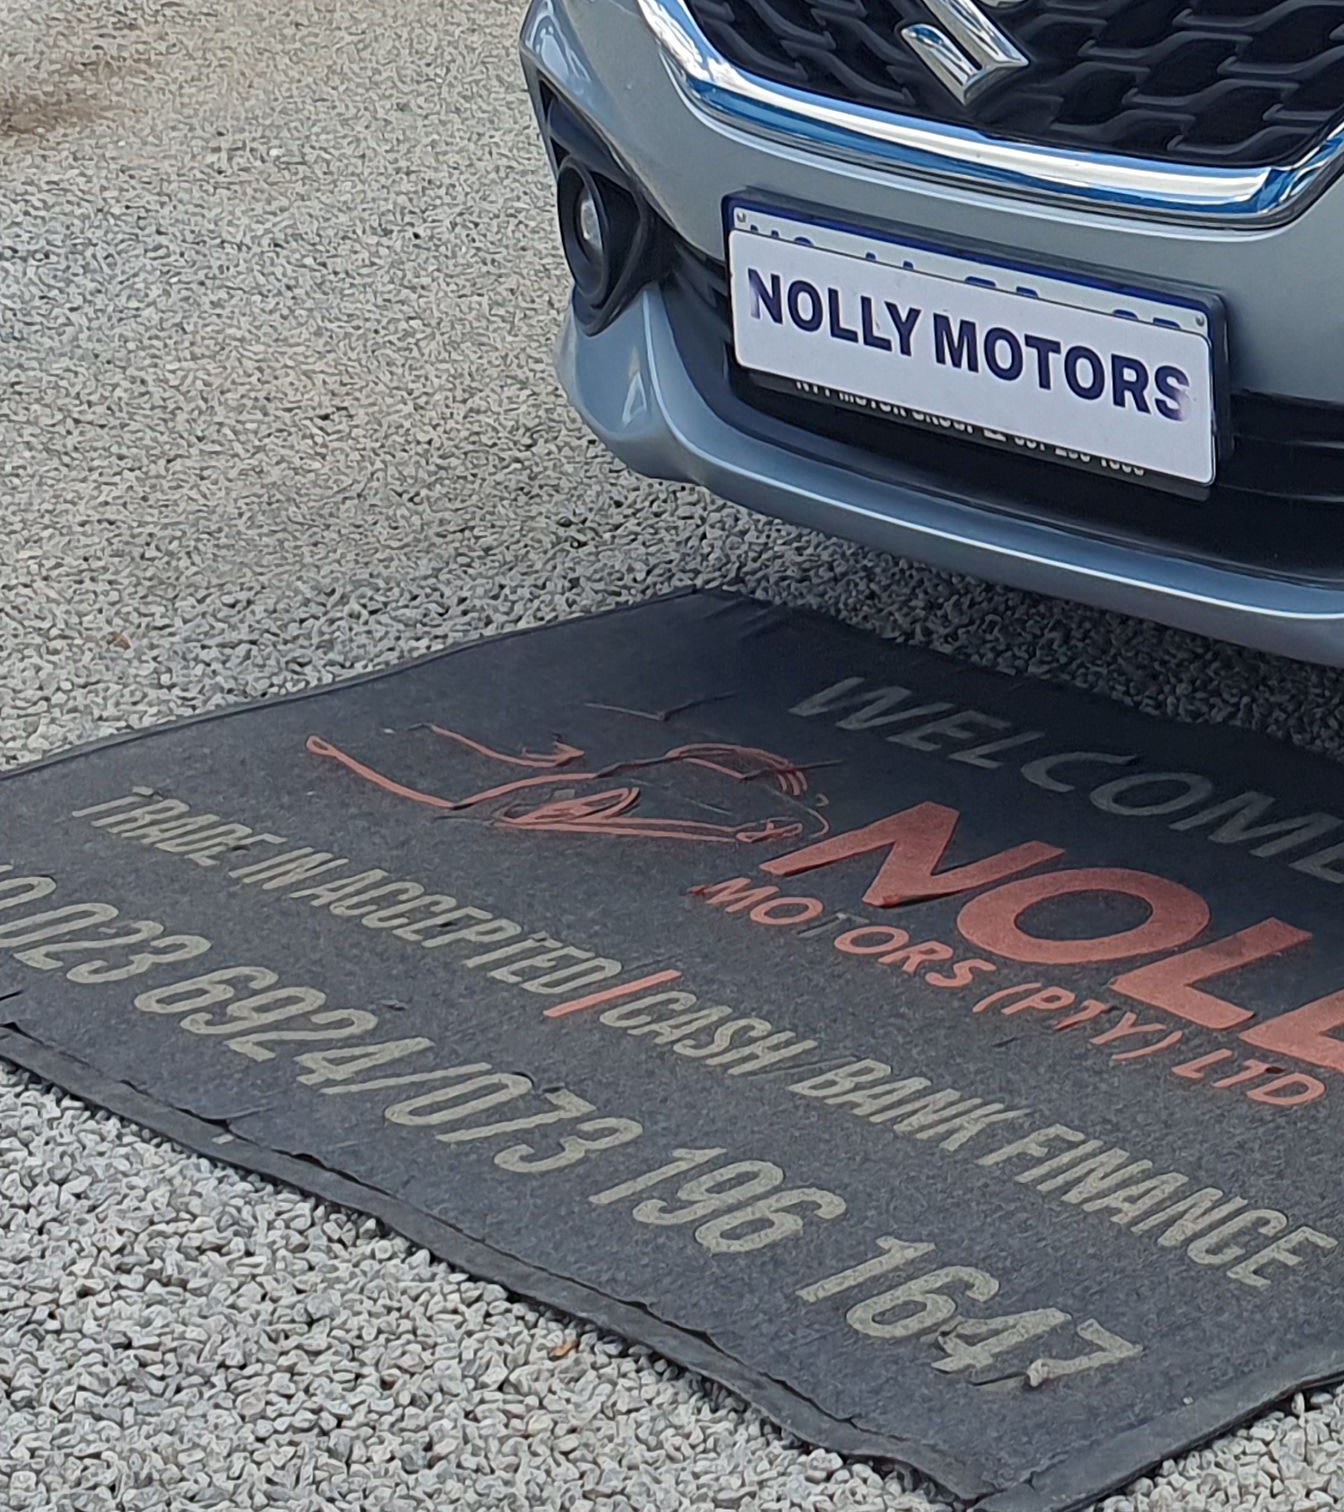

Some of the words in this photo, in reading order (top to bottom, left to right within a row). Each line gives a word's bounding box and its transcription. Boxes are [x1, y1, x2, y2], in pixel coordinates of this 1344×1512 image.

[746, 267, 922, 357] NOLLY
[932, 311, 1192, 423] MOTORS
[72, 786, 287, 867] TRADE
[228, 846, 350, 890] IN
[979, 1122, 1340, 1289] FINANCE
[690, 876, 997, 988] MOTORS
[972, 982, 1184, 1062] (PTY)
[1171, 1048, 1327, 1106] LTD
[588, 1145, 848, 1255] 196
[798, 1235, 1146, 1389] 1647
